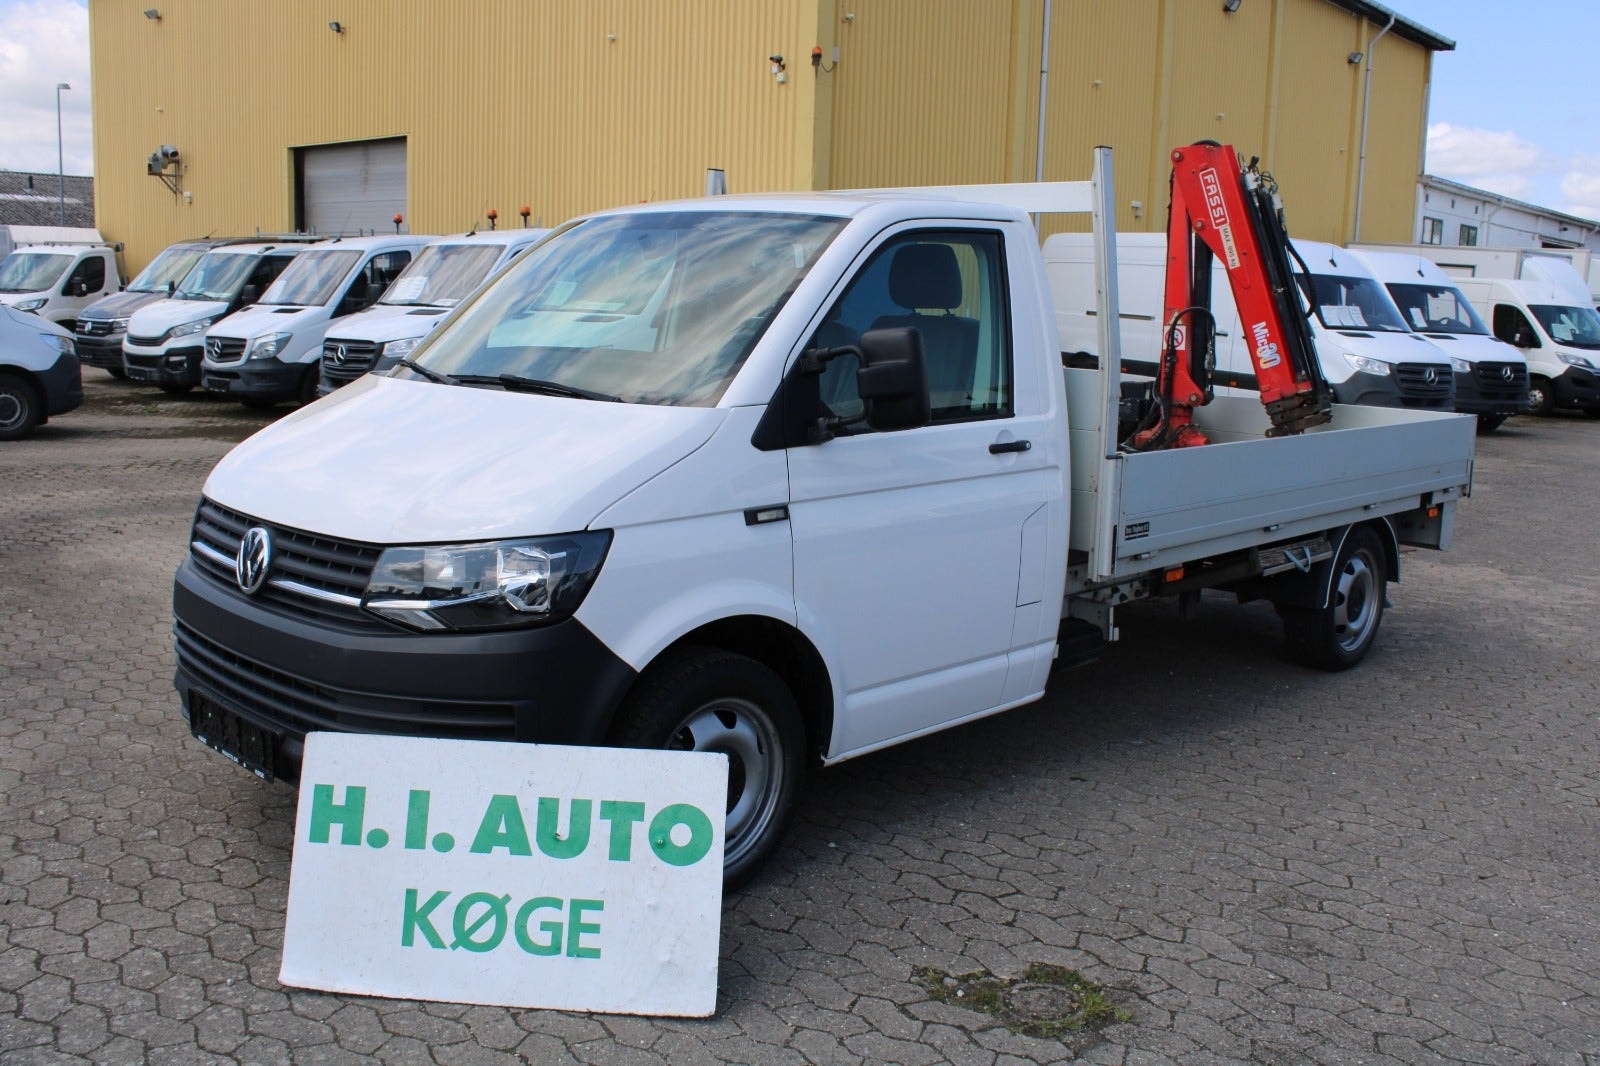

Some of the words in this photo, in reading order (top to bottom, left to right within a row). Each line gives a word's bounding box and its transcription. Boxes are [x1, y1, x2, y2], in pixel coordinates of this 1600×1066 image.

[1203, 174, 1226, 224] FASSI
[470, 795, 713, 867] AUTO
[401, 888, 604, 960] KØGE
